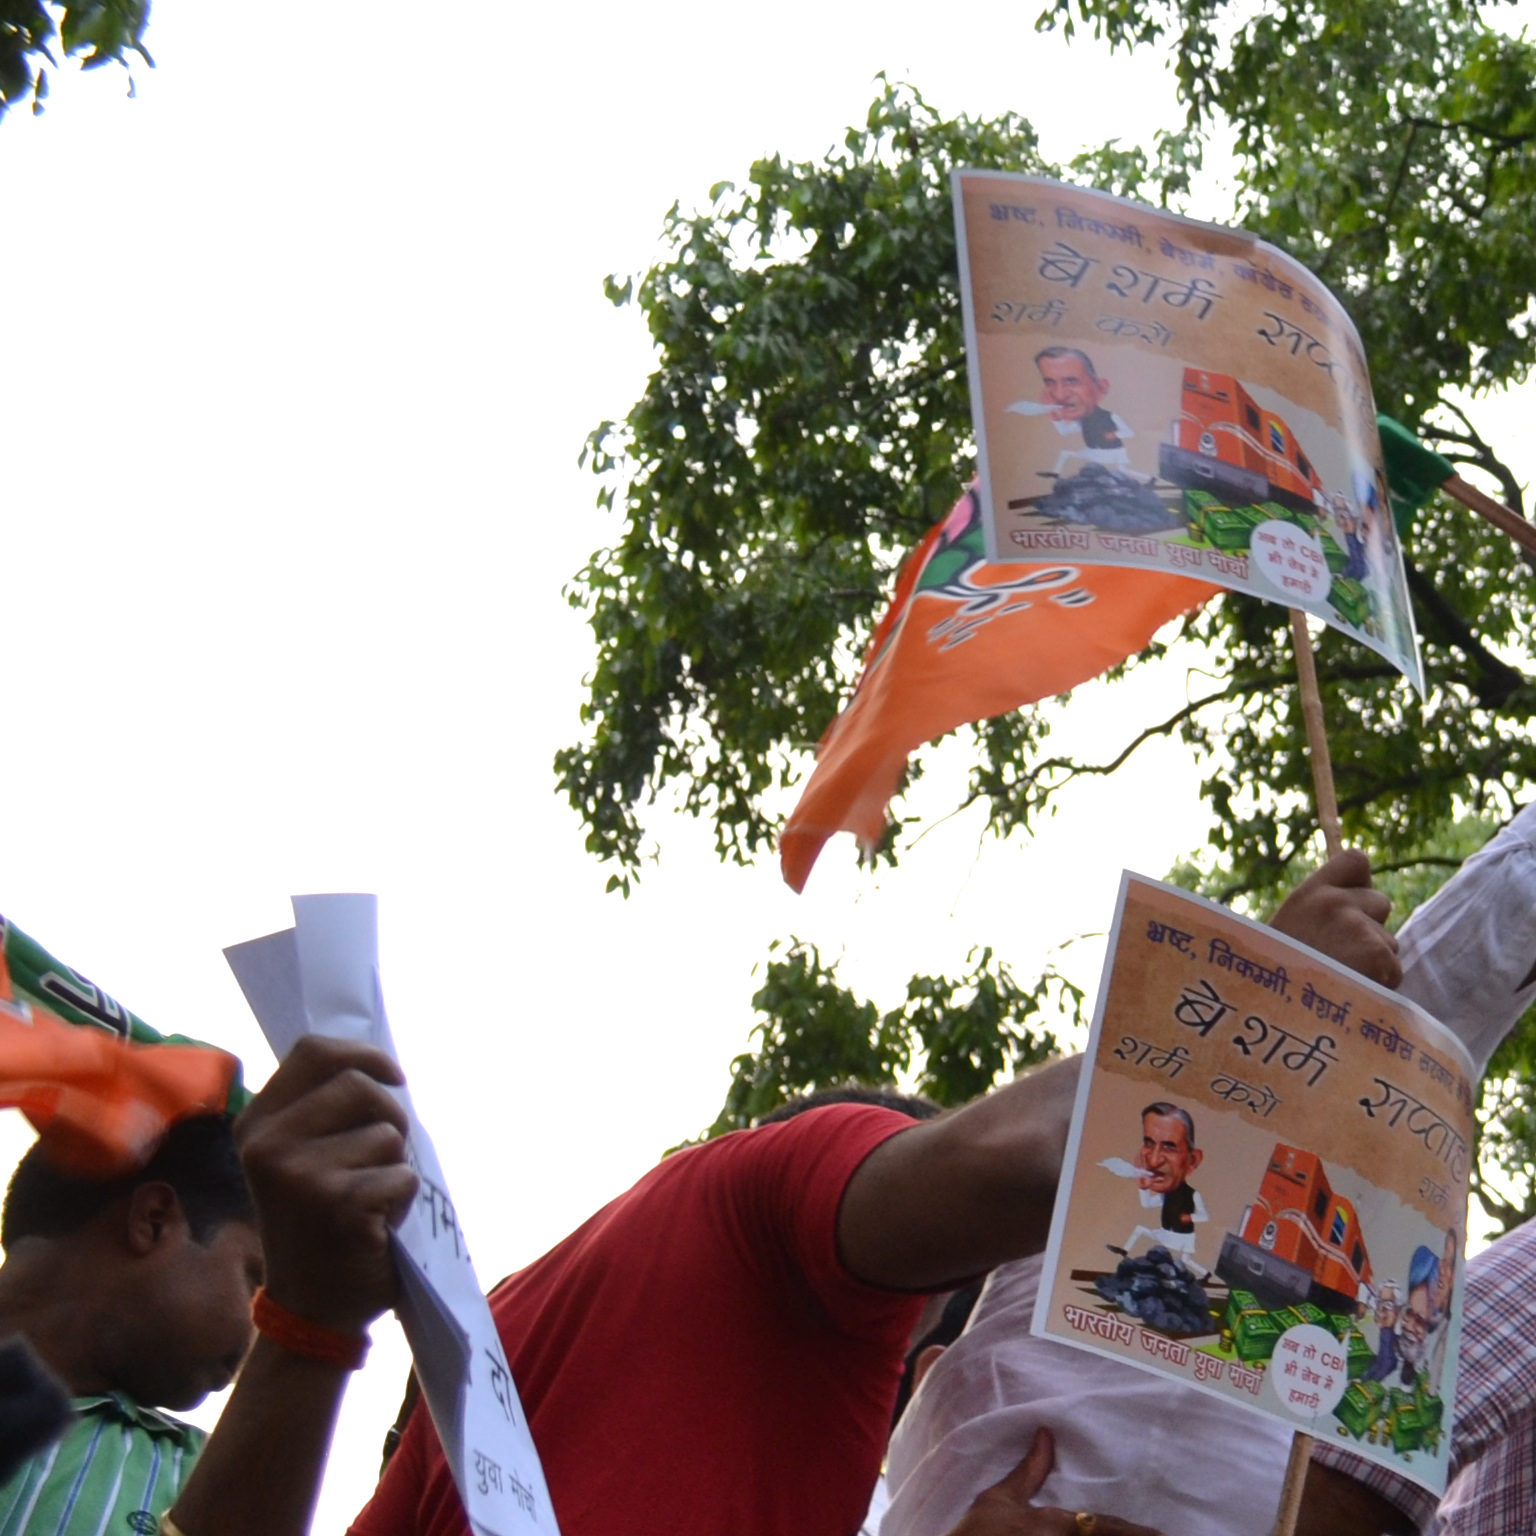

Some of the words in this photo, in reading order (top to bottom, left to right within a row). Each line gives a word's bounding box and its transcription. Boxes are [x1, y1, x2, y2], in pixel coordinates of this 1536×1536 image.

[989, 298, 1071, 327] शर्म
[1095, 313, 1177, 347] करो
[1010, 526, 1090, 550] भारतीय
[1099, 533, 1159, 557] जनता
[1165, 541, 1202, 568] युवा
[1146, 920, 1197, 960] भ्रष्ट,
[1207, 938, 1292, 1002] निकम्मी,
[1299, 986, 1351, 1035] बेशर्म,
[1359, 1016, 1415, 1063] कांग्रेस
[1112, 1035, 1194, 1079] शर्म
[1210, 1071, 1283, 1118] करो
[1063, 1304, 1135, 1346] भारतीय
[1141, 1328, 1192, 1366] जनता
[1193, 1350, 1226, 1381] युवा
[1228, 1358, 1263, 1396] मोर्चा
[1320, 1352, 1345, 1372] CBI
